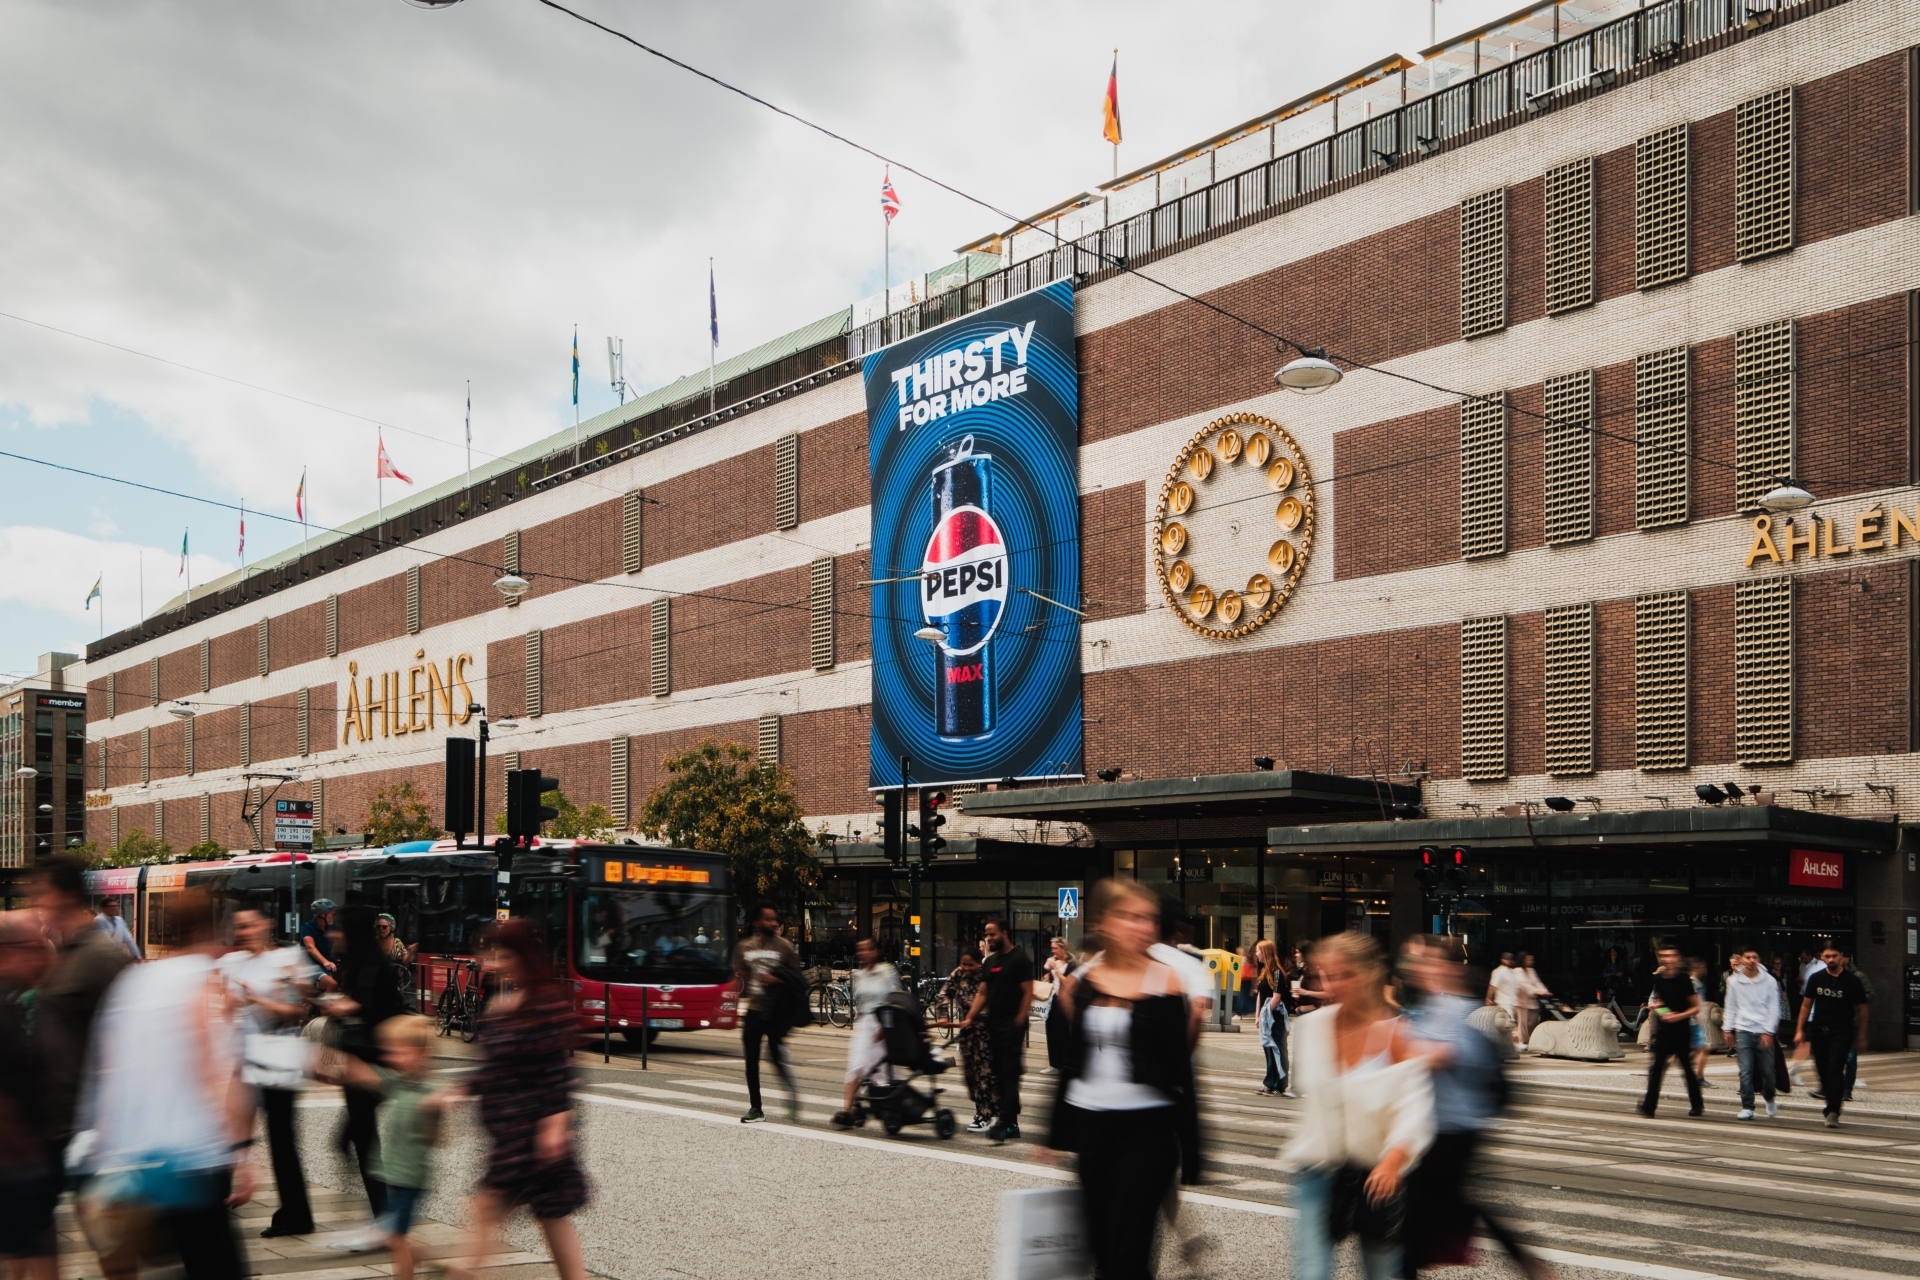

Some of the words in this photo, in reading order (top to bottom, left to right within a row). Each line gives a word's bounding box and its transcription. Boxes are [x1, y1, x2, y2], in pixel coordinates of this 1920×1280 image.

[891, 320, 1036, 405] THIRSTY
[900, 394, 947, 431] FOR
[951, 366, 1027, 414] MORE
[1222, 432, 1237, 460] 12
[1254, 438, 1263, 463] 1
[1195, 453, 1207, 477] 11
[1276, 462, 1287, 488] 2
[1174, 485, 1189, 512] 10
[1284, 501, 1296, 528] 3
[1169, 527, 1179, 551] 9
[1275, 543, 1286, 568] 4
[927, 558, 1002, 601] PEPSI
[1175, 565, 1185, 588] 8
[1197, 590, 1207, 615] 7
[1254, 579, 1265, 604] 5
[1224, 594, 1236, 619] 6
[946, 663, 983, 684] MAX
[343, 648, 473, 745] ÅHLÉNS
[290, 802, 296, 811] N
[1802, 857, 1839, 877] ÅHLÉNS
[1766, 897, 1823, 908] T-Centralen
[1816, 987, 1843, 998] BOSS
